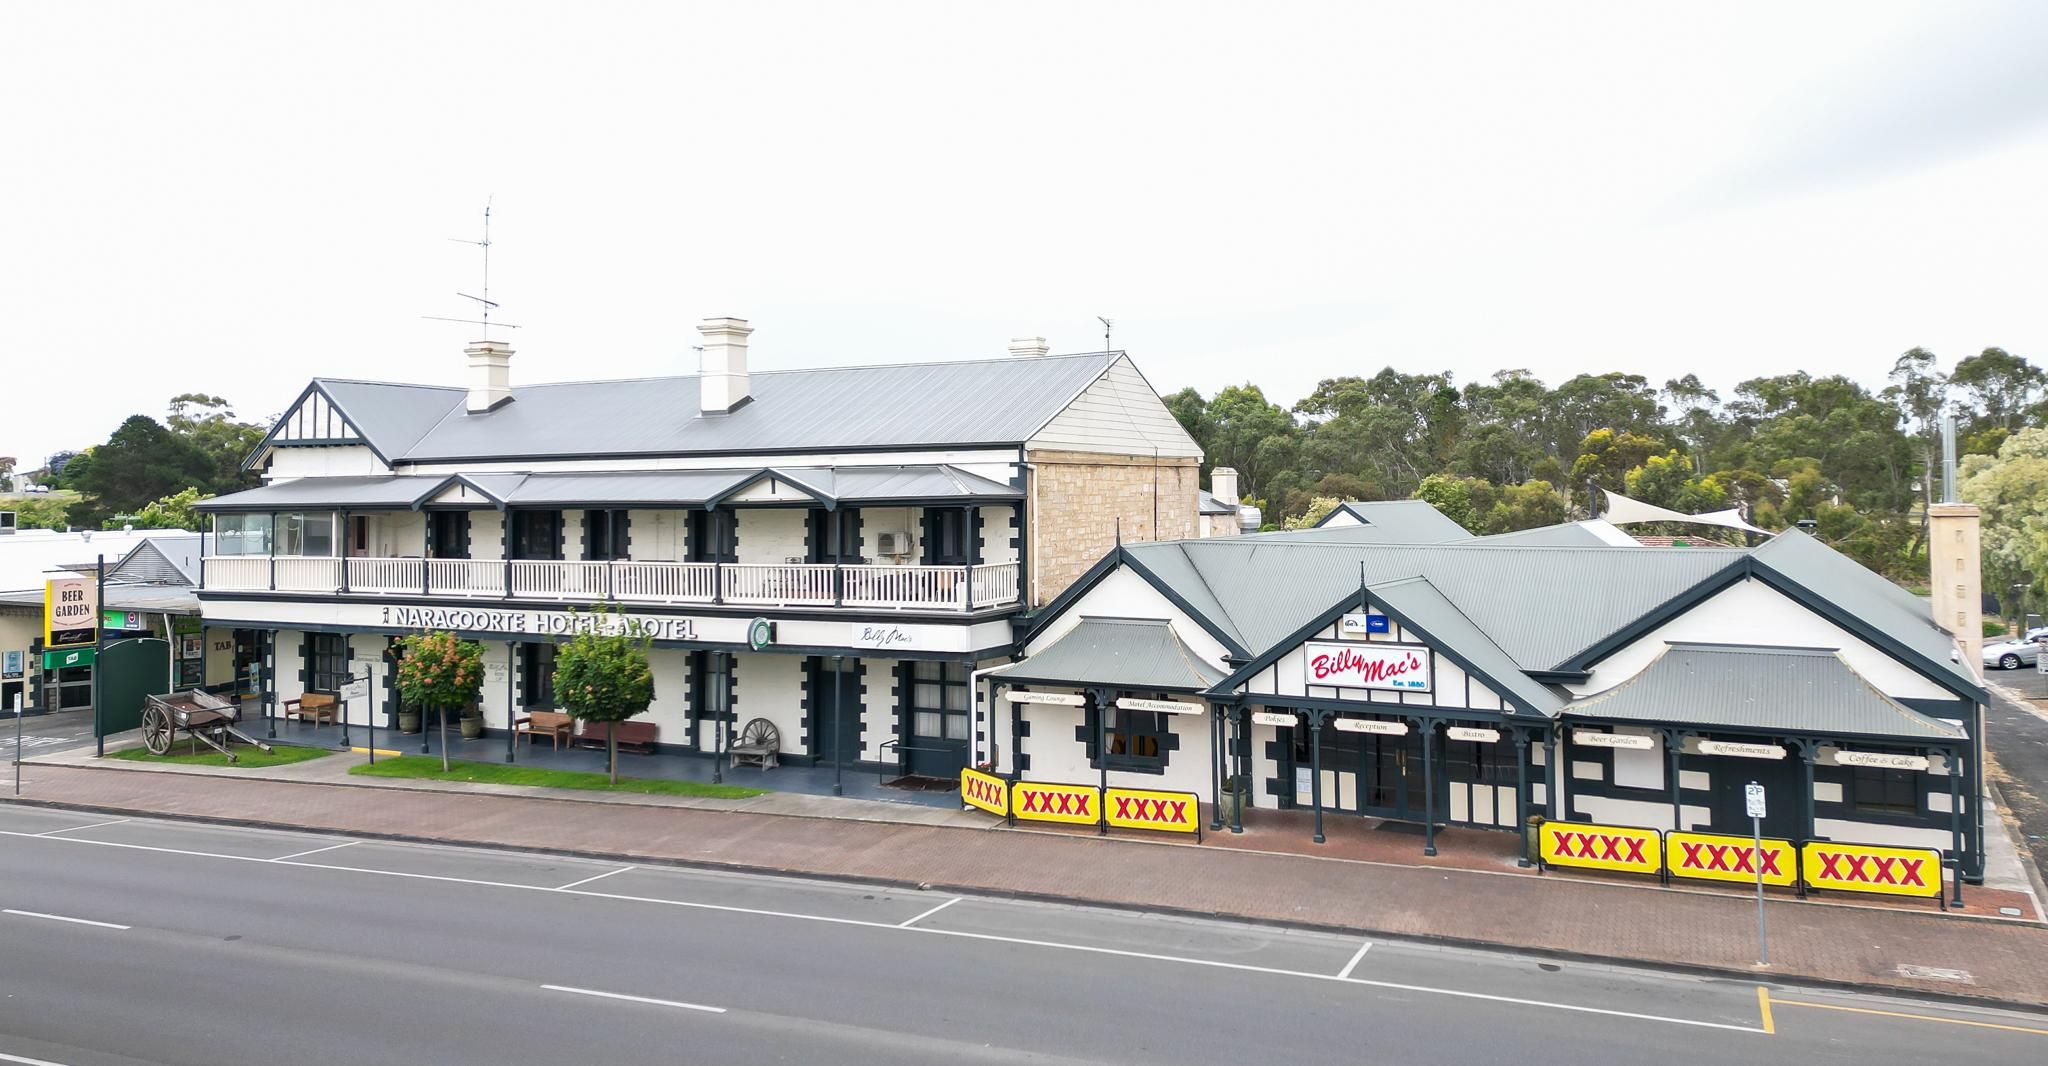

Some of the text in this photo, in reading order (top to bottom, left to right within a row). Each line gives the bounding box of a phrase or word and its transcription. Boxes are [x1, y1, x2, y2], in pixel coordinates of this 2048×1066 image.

[62, 590, 83, 602] BEER
[56, 604, 90, 617] GARDEN
[395, 607, 526, 632] NARACOORTE
[535, 613, 602, 635] HOTEL
[214, 640, 232, 651] TAB
[1311, 648, 1422, 683] Billy Mac's
[1145, 702, 1193, 712] Accommodation
[1354, 721, 1388, 732] Reception
[1463, 730, 1486, 738] Bistro
[1589, 735, 1638, 745] Beer Garden
[1712, 743, 1770, 755] Refreshments
[1849, 753, 1879, 764] Coffee
[1891, 757, 1915, 767] Cake
[966, 775, 1003, 807] XXXX
[1748, 787, 1763, 796] 2P
[1022, 790, 1091, 817] XXXX
[1115, 796, 1188, 824] XXXX
[1553, 831, 1647, 864] XXXX
[1681, 842, 1783, 876] XXXX
[1818, 852, 1926, 887] XXXX
